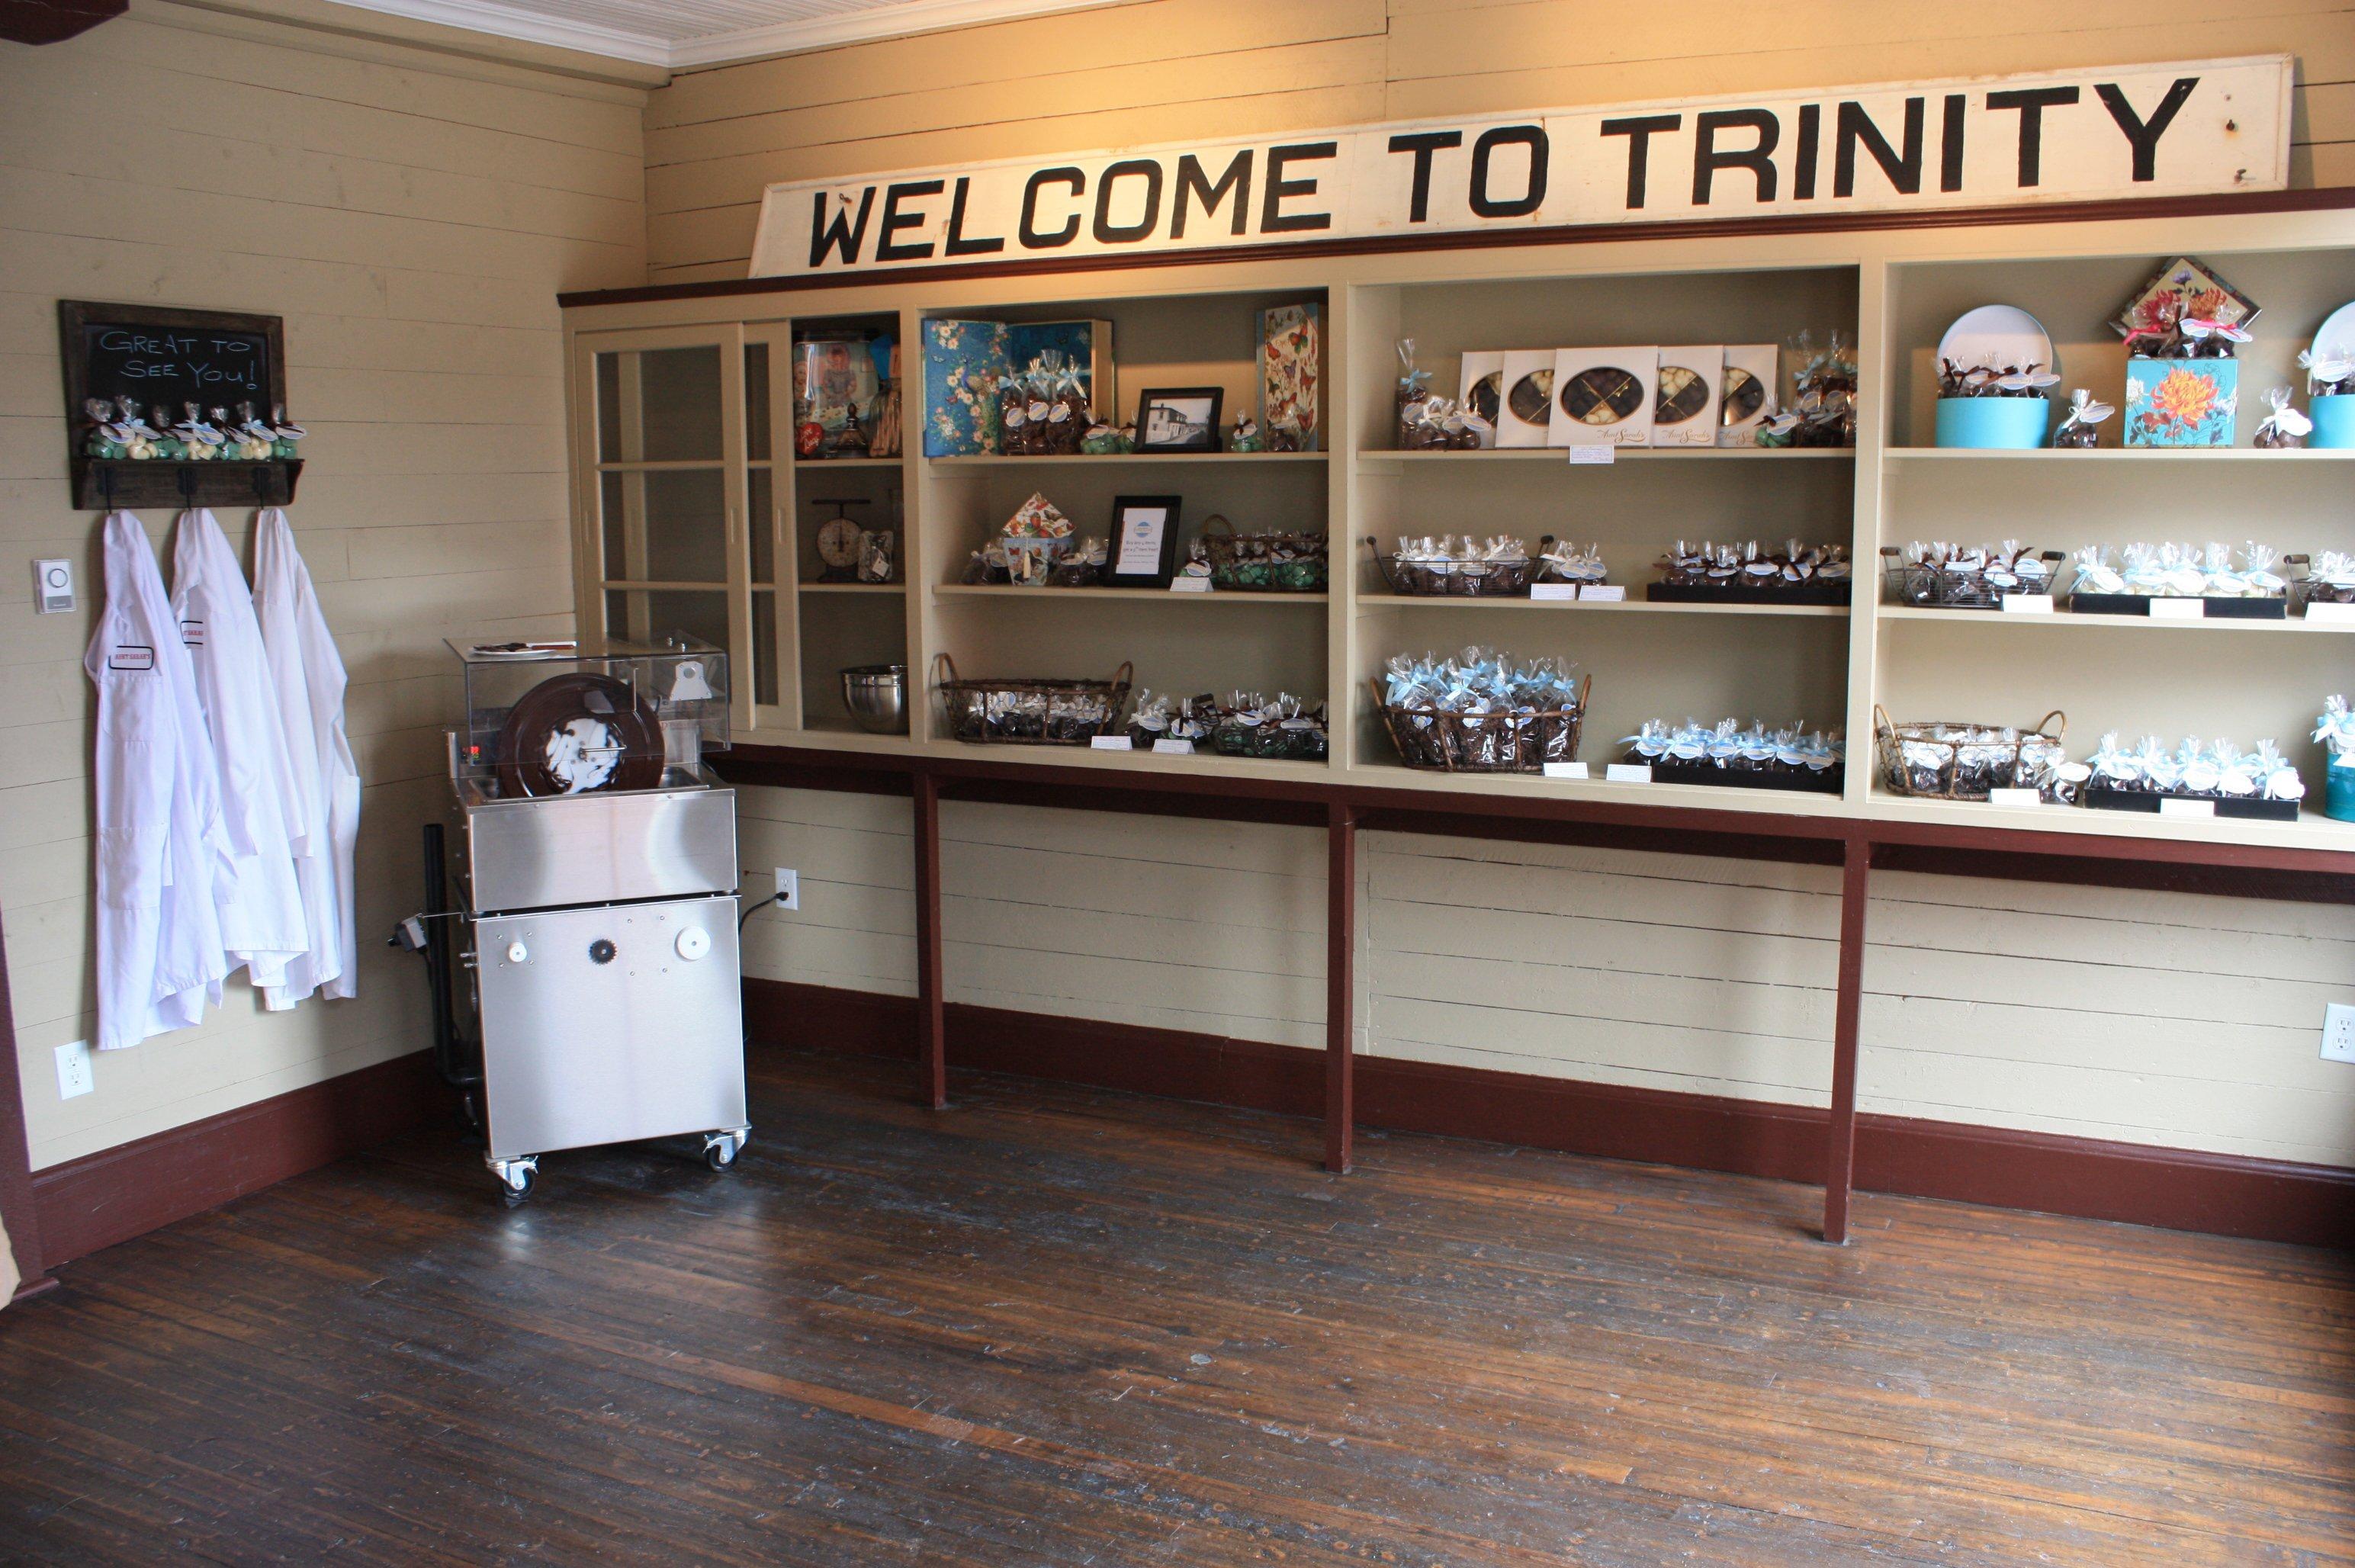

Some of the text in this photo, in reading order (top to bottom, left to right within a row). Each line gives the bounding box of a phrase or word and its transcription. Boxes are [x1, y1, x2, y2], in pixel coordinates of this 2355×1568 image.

[808, 76, 2201, 268] WELCOME TO TRINITY
[100, 331, 251, 354] GREAT TO
[120, 360, 179, 378] SEE
[1597, 429, 1618, 439] Aunt
